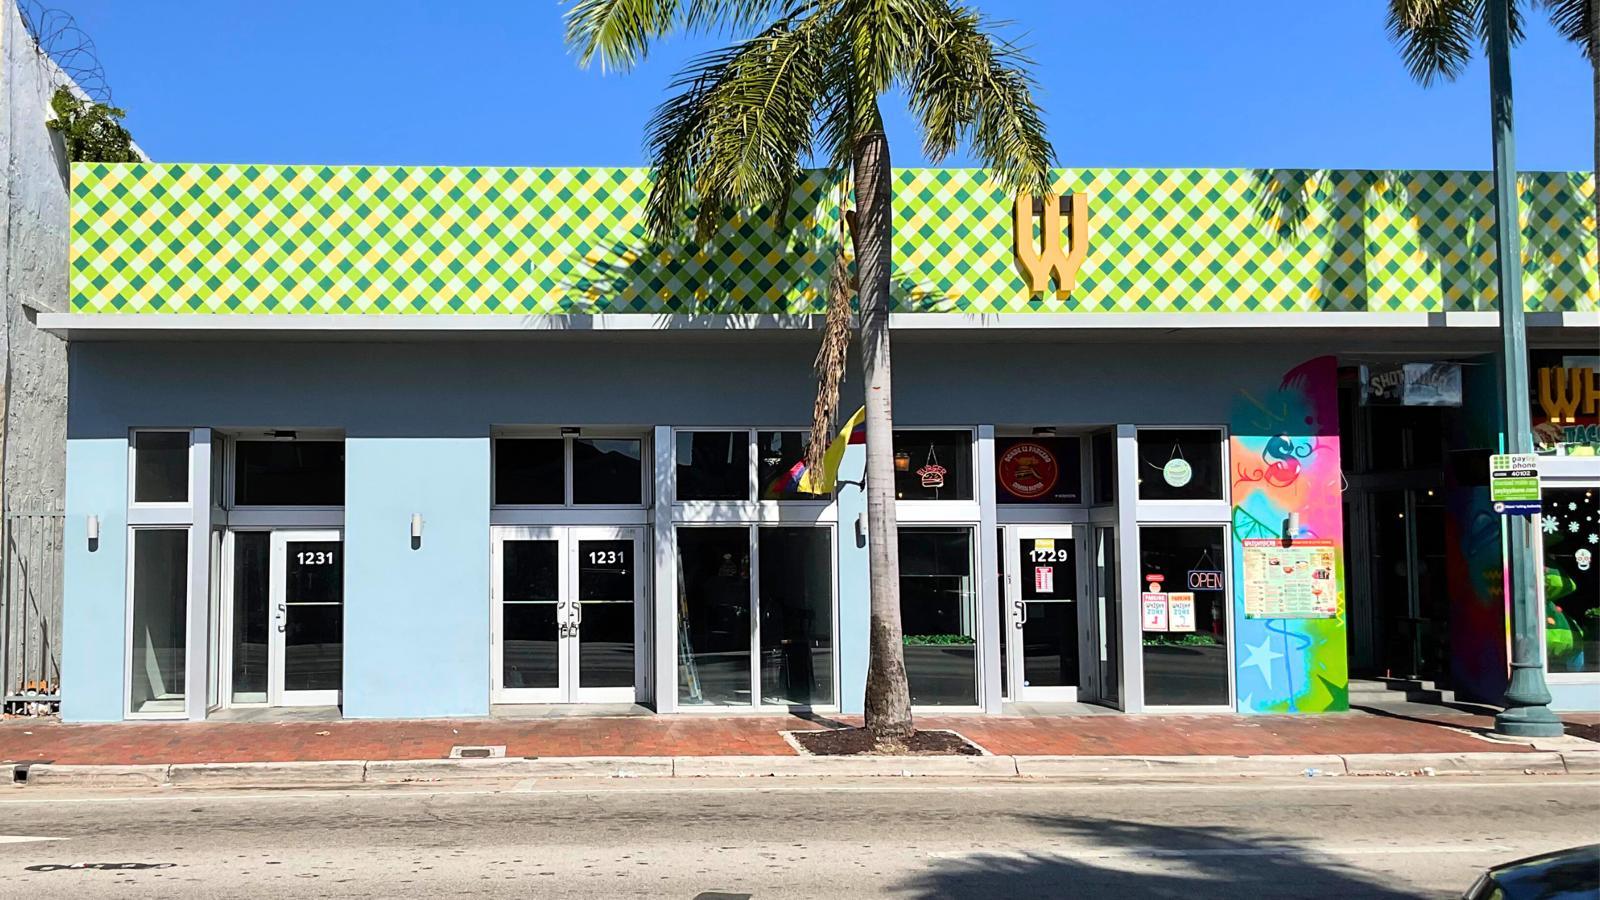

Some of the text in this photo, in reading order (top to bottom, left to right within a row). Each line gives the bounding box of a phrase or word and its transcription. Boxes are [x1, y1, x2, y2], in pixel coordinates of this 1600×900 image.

[916, 464, 947, 476] BURGER
[297, 551, 333, 565] 1231
[589, 551, 624, 564] 1231
[1029, 549, 1067, 562] 1229
[1190, 572, 1222, 589] OPEN
